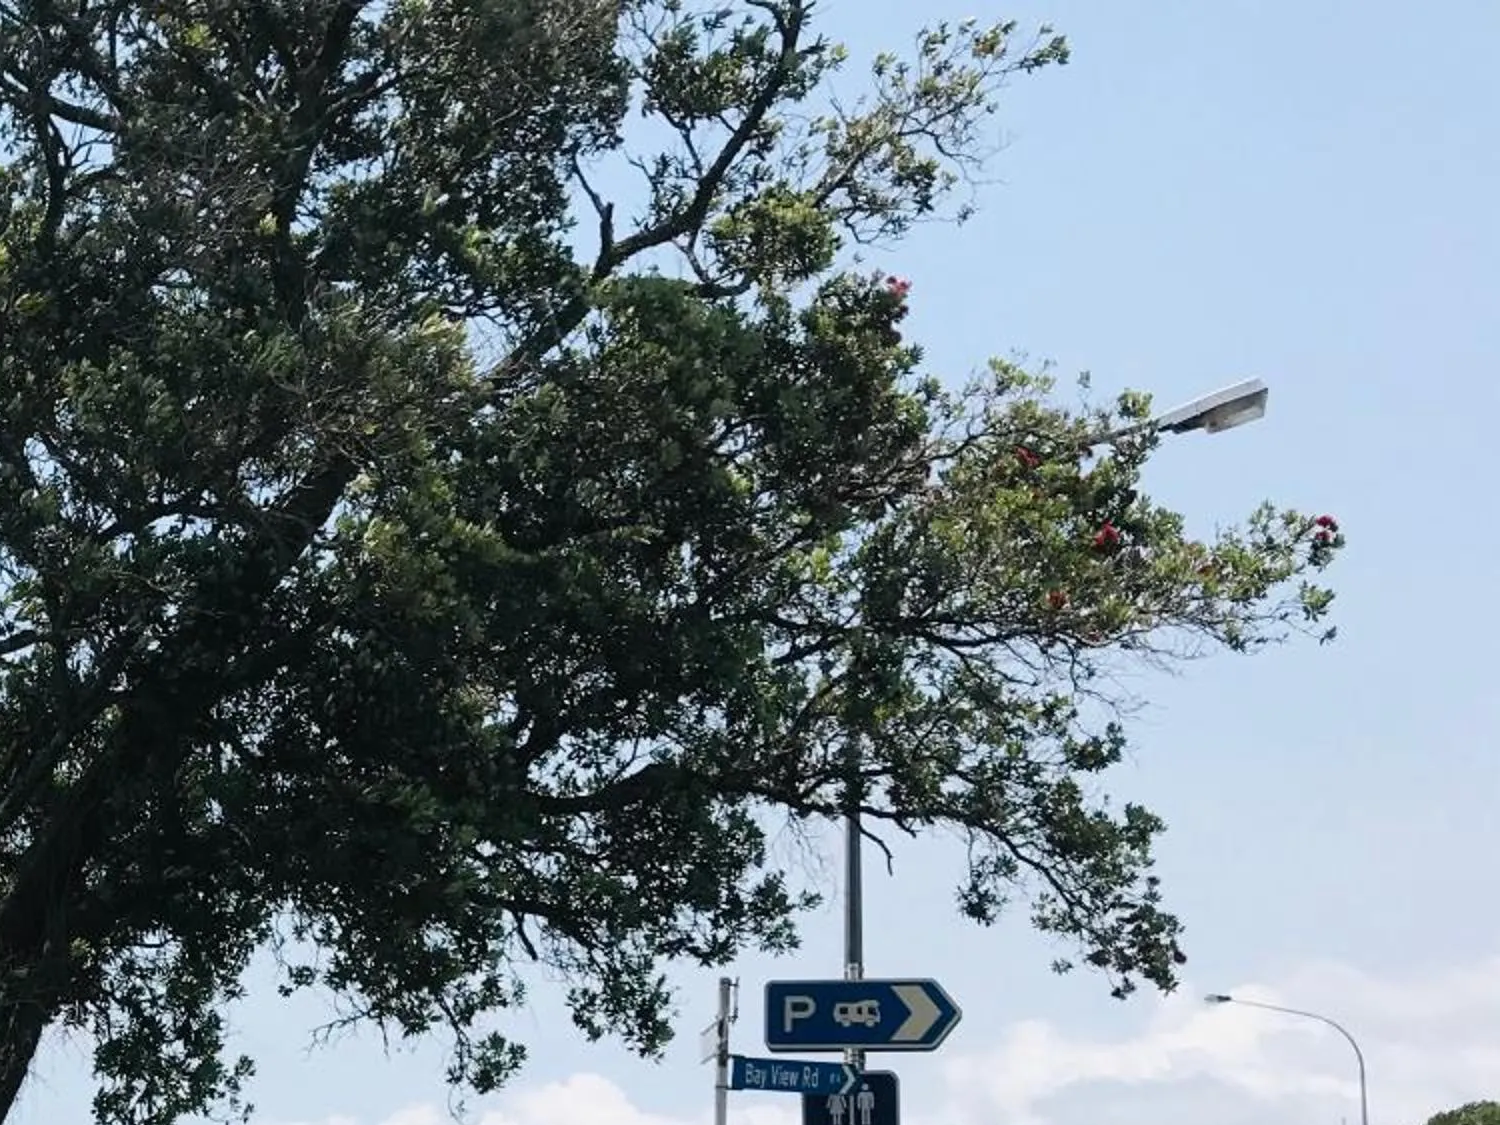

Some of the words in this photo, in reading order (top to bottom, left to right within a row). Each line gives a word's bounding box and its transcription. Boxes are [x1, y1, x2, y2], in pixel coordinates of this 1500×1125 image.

[783, 995, 817, 1033] P
[745, 1063, 767, 1089] Bay
[771, 1064, 800, 1088] View
[801, 1066, 820, 1089] Rd
